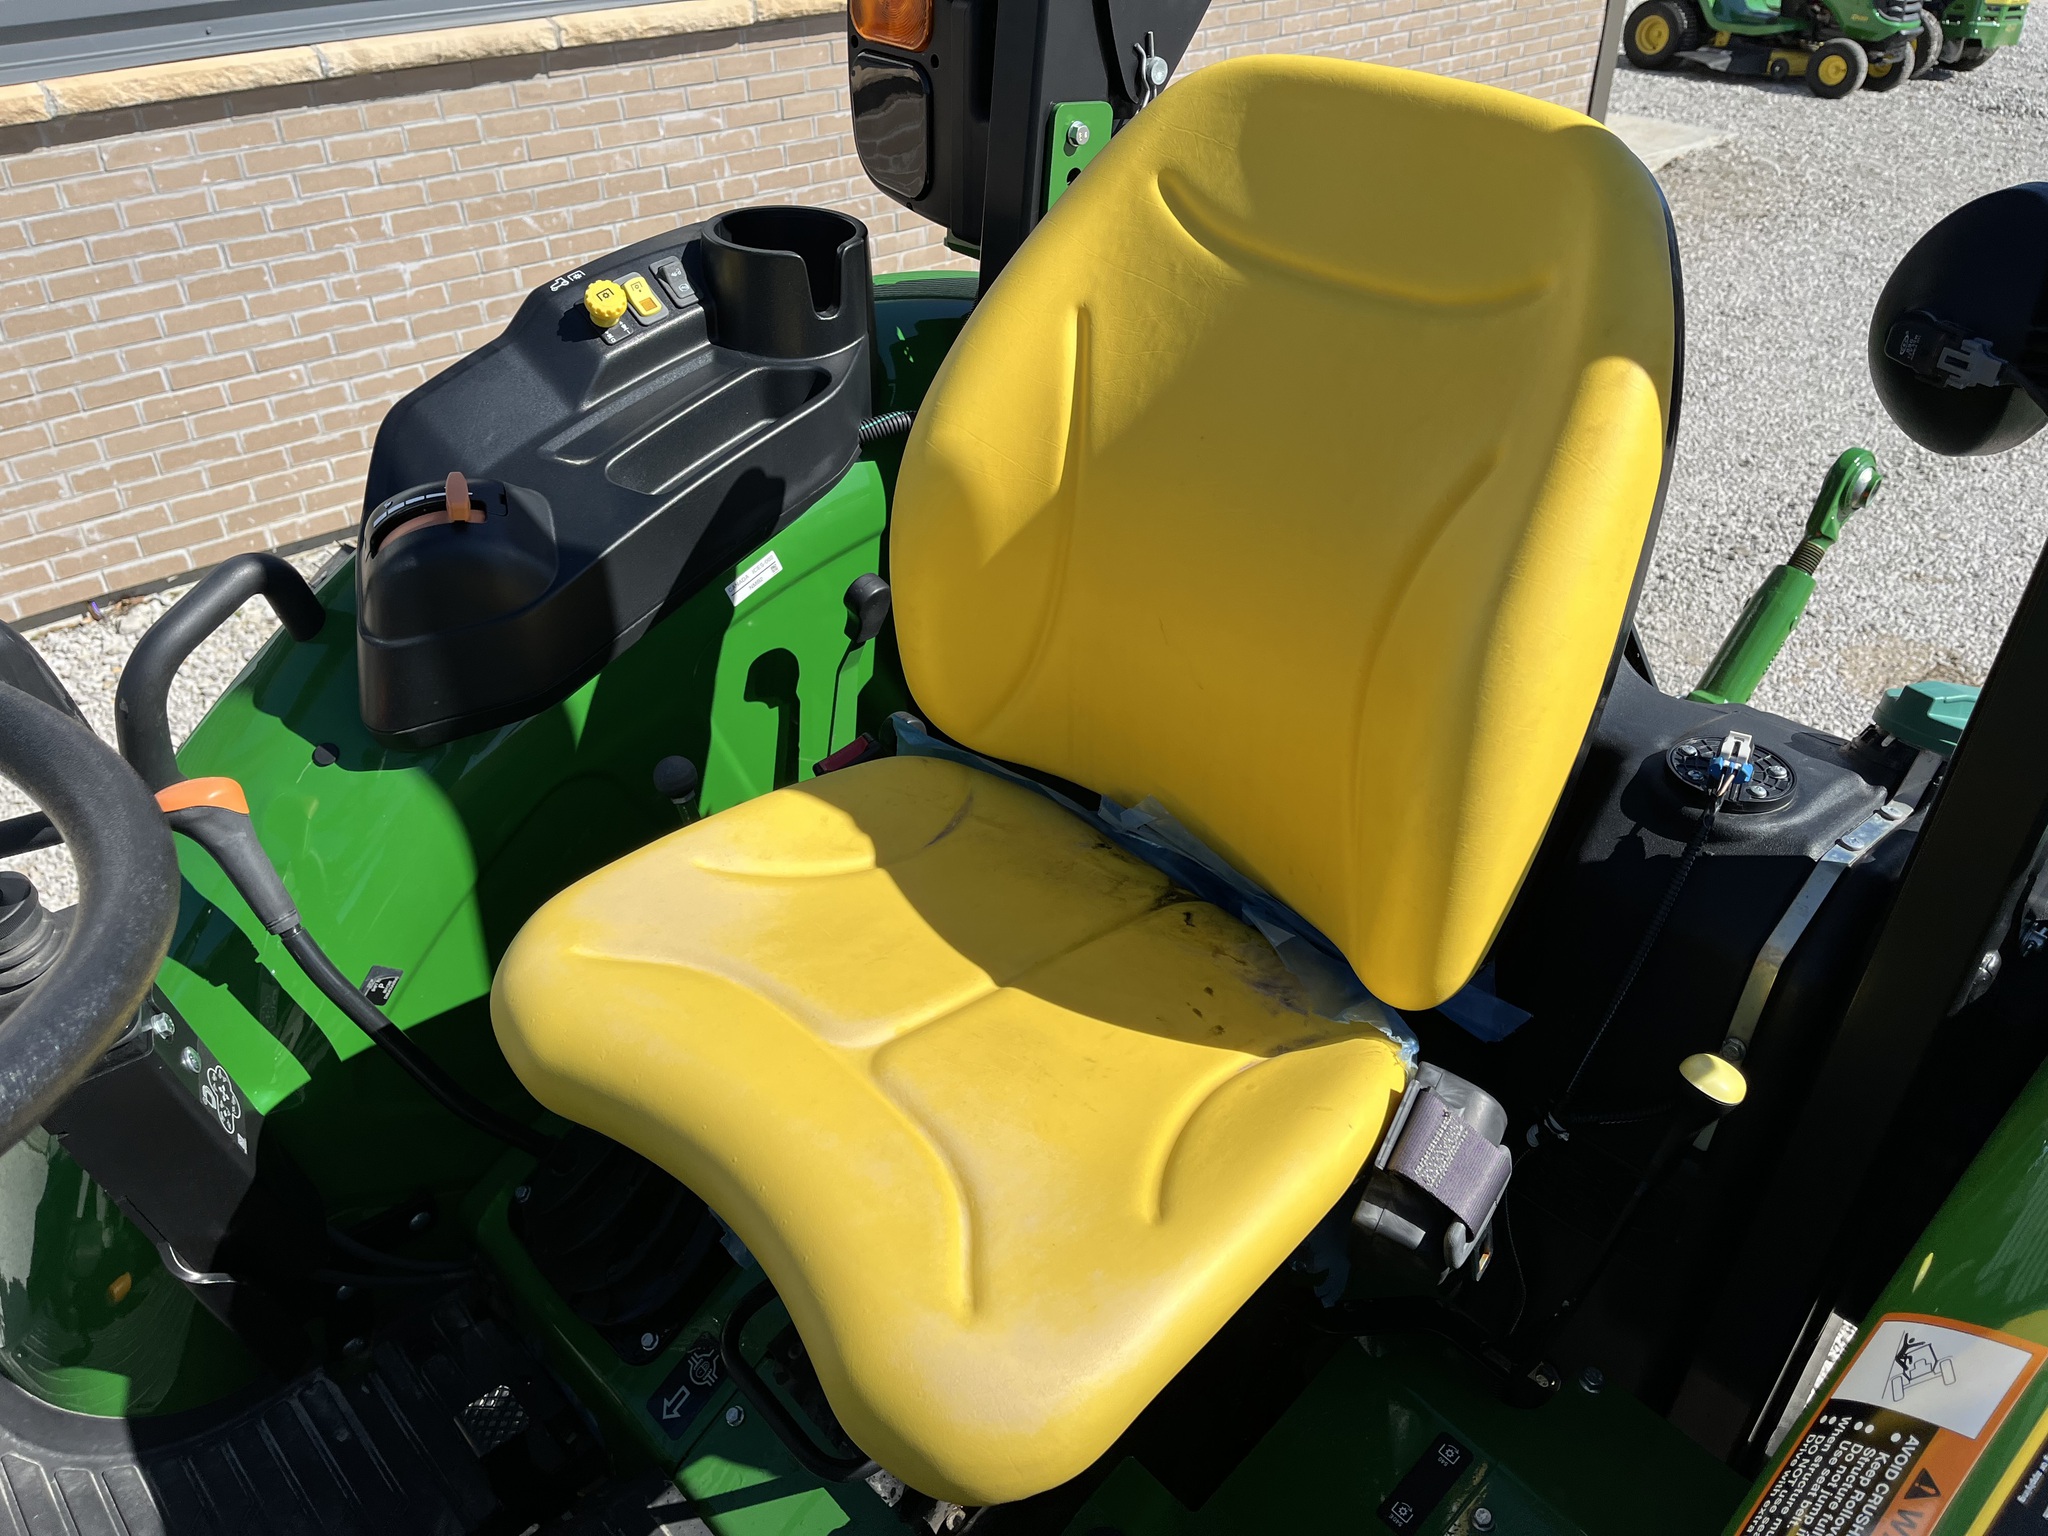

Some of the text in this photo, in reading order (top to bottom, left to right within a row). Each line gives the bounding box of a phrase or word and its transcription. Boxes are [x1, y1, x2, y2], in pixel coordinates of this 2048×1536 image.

[728, 574, 749, 592] CANADA
[1807, 1435, 1826, 1455] DO
[1821, 1416, 1853, 1452] When
[1437, 1456, 1449, 1467] 540
[1844, 1443, 1864, 1462] Do
[1746, 1434, 1816, 1533] Drive with extra
[1788, 1458, 1810, 1487] NOT
[1827, 1465, 1848, 1489] not
[1859, 1451, 1891, 1487] Keep
[1780, 1455, 1823, 1515] structure
[1786, 1440, 1852, 1528] Use seat belt.
[1811, 1446, 1877, 1536] Structure full
[1846, 1434, 1920, 1536] AVOID CRUSH
[1768, 1489, 1788, 1513] use
[1804, 1488, 1833, 1525] jump
[1388, 1513, 1404, 1528] 540E
[1882, 1508, 1923, 1536] W
